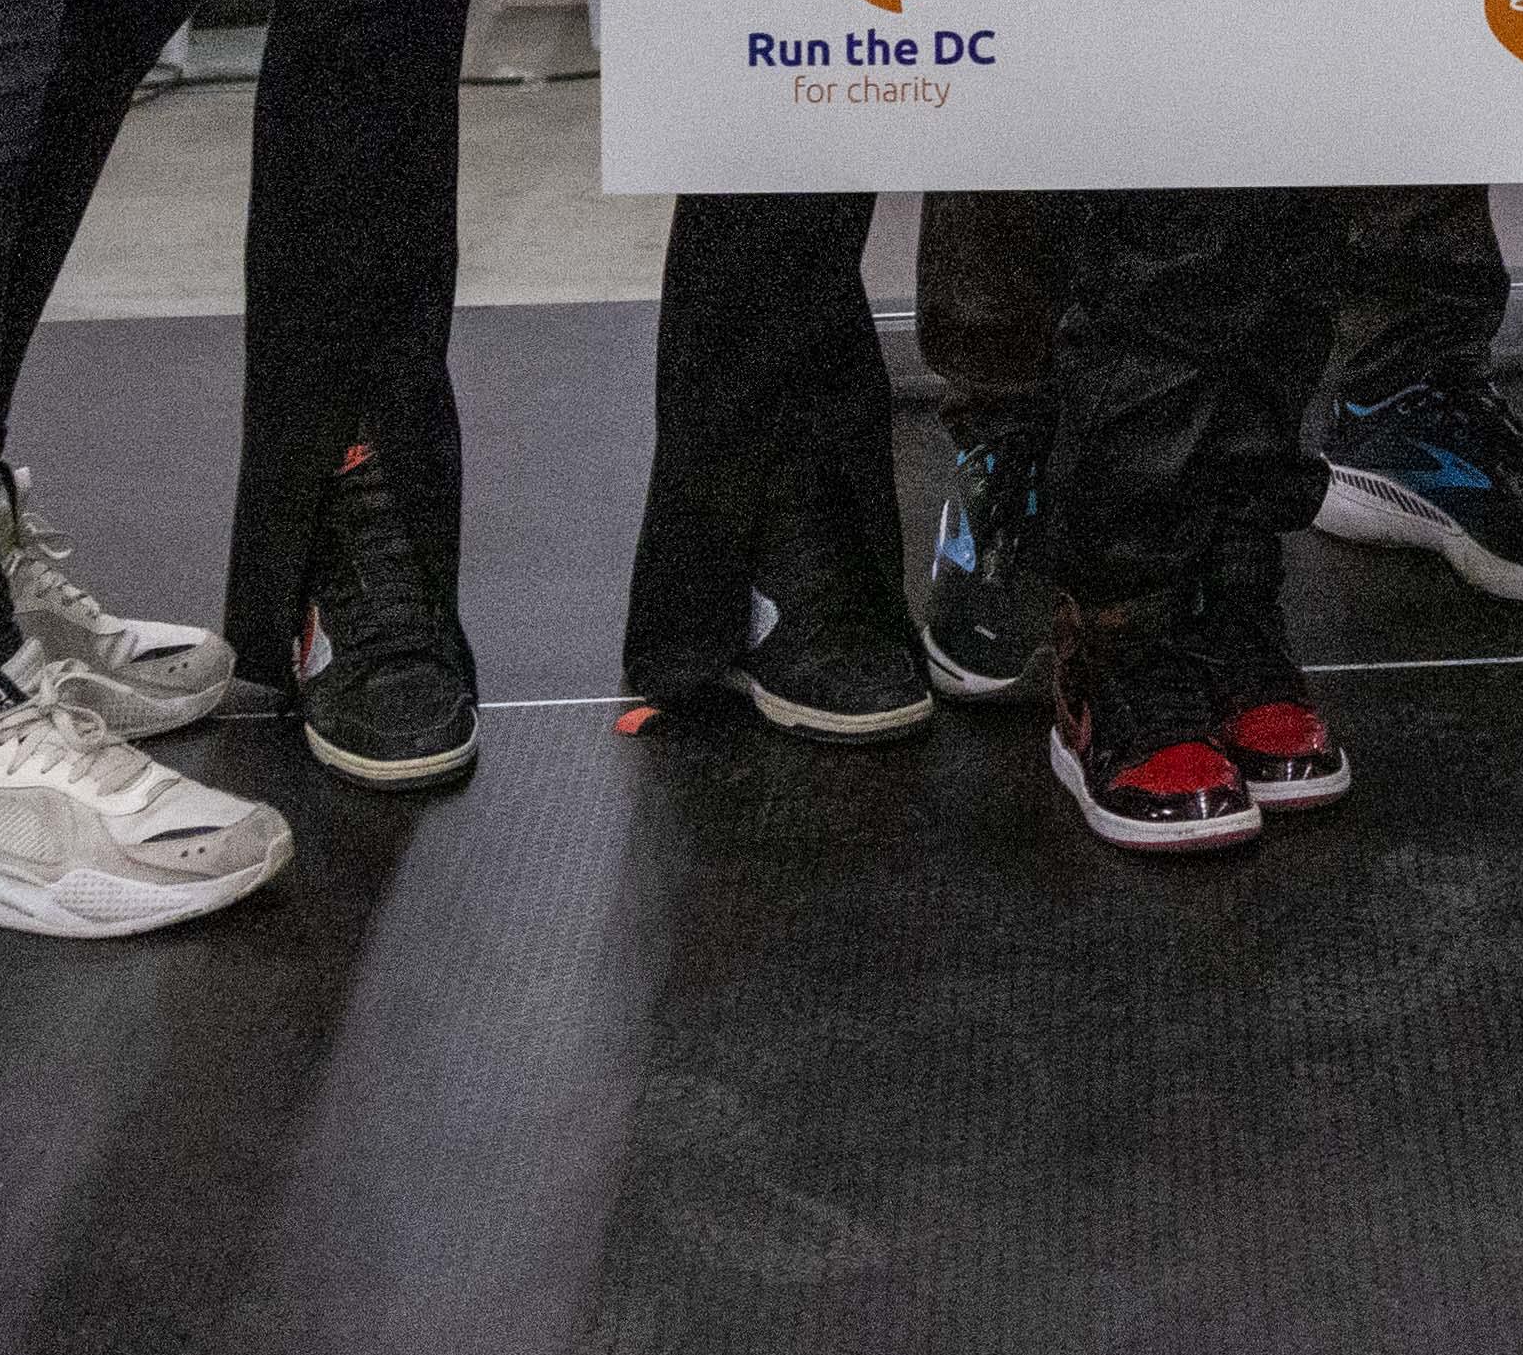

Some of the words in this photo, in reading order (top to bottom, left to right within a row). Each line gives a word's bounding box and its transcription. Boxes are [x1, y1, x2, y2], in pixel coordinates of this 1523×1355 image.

[748, 31, 831, 68] Run
[846, 27, 920, 67] the
[934, 29, 997, 66] DC
[793, 75, 838, 105] for
[847, 74, 951, 108] charity
